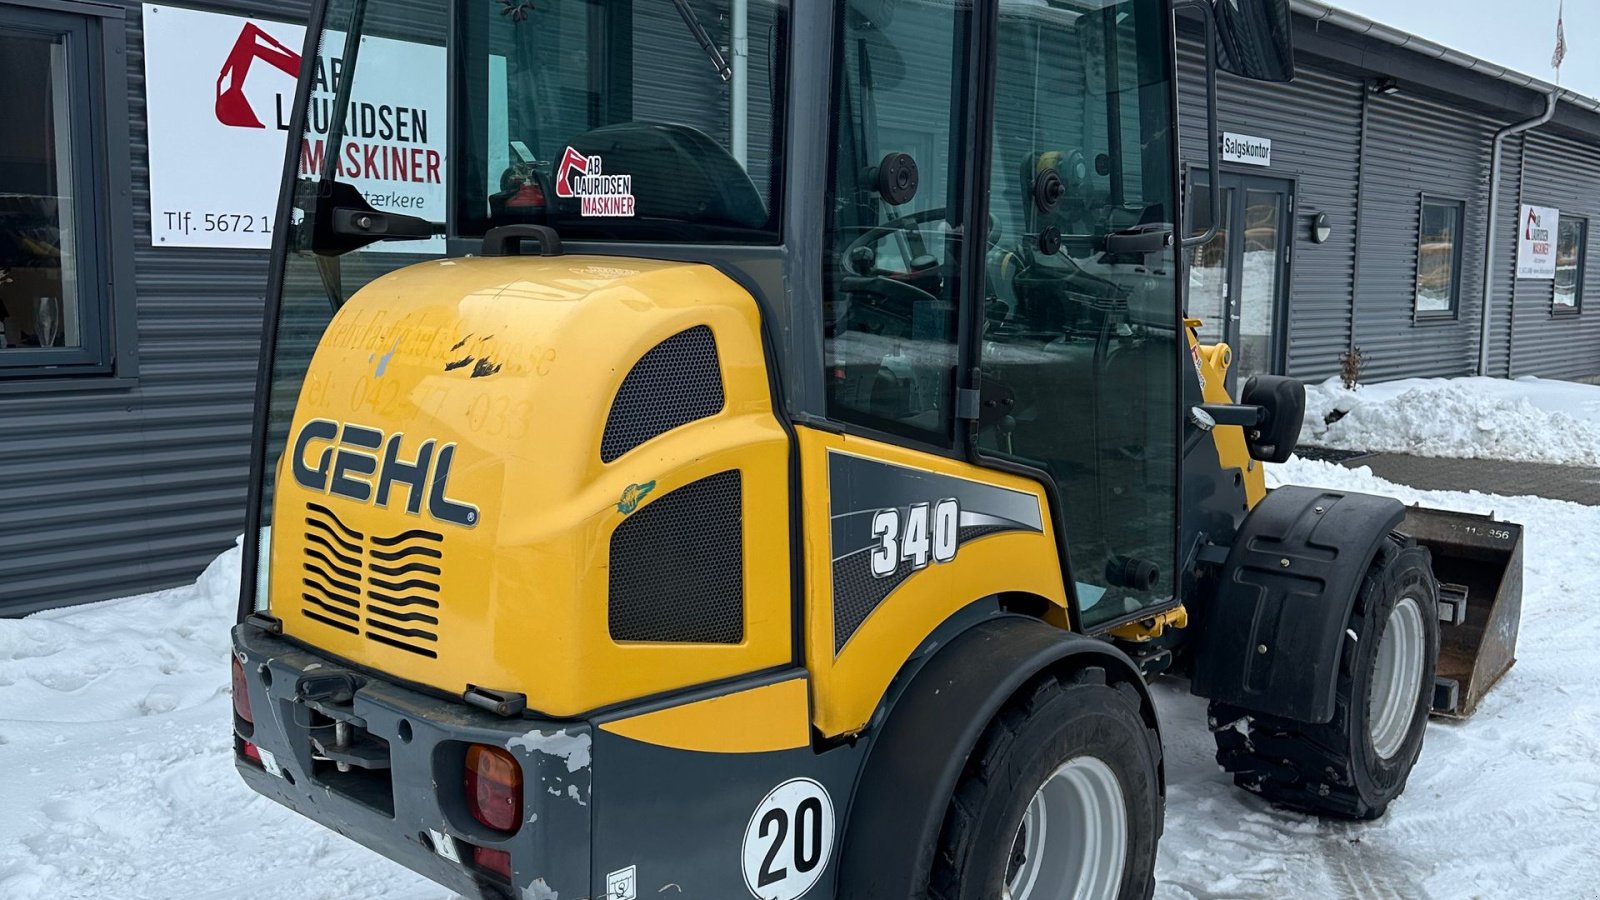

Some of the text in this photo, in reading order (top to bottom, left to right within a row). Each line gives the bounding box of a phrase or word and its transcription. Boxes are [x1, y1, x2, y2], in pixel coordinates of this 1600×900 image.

[1225, 138, 1269, 158] Salgskontor
[587, 157, 600, 175] AB
[575, 177, 630, 195] LAURIDSEN
[582, 197, 634, 215] MASKINER
[164, 211, 197, 235] Tlf.
[205, 213, 254, 233] 5672
[292, 417, 480, 528] GEHL
[871, 498, 960, 578] 340
[757, 797, 822, 888] 20
